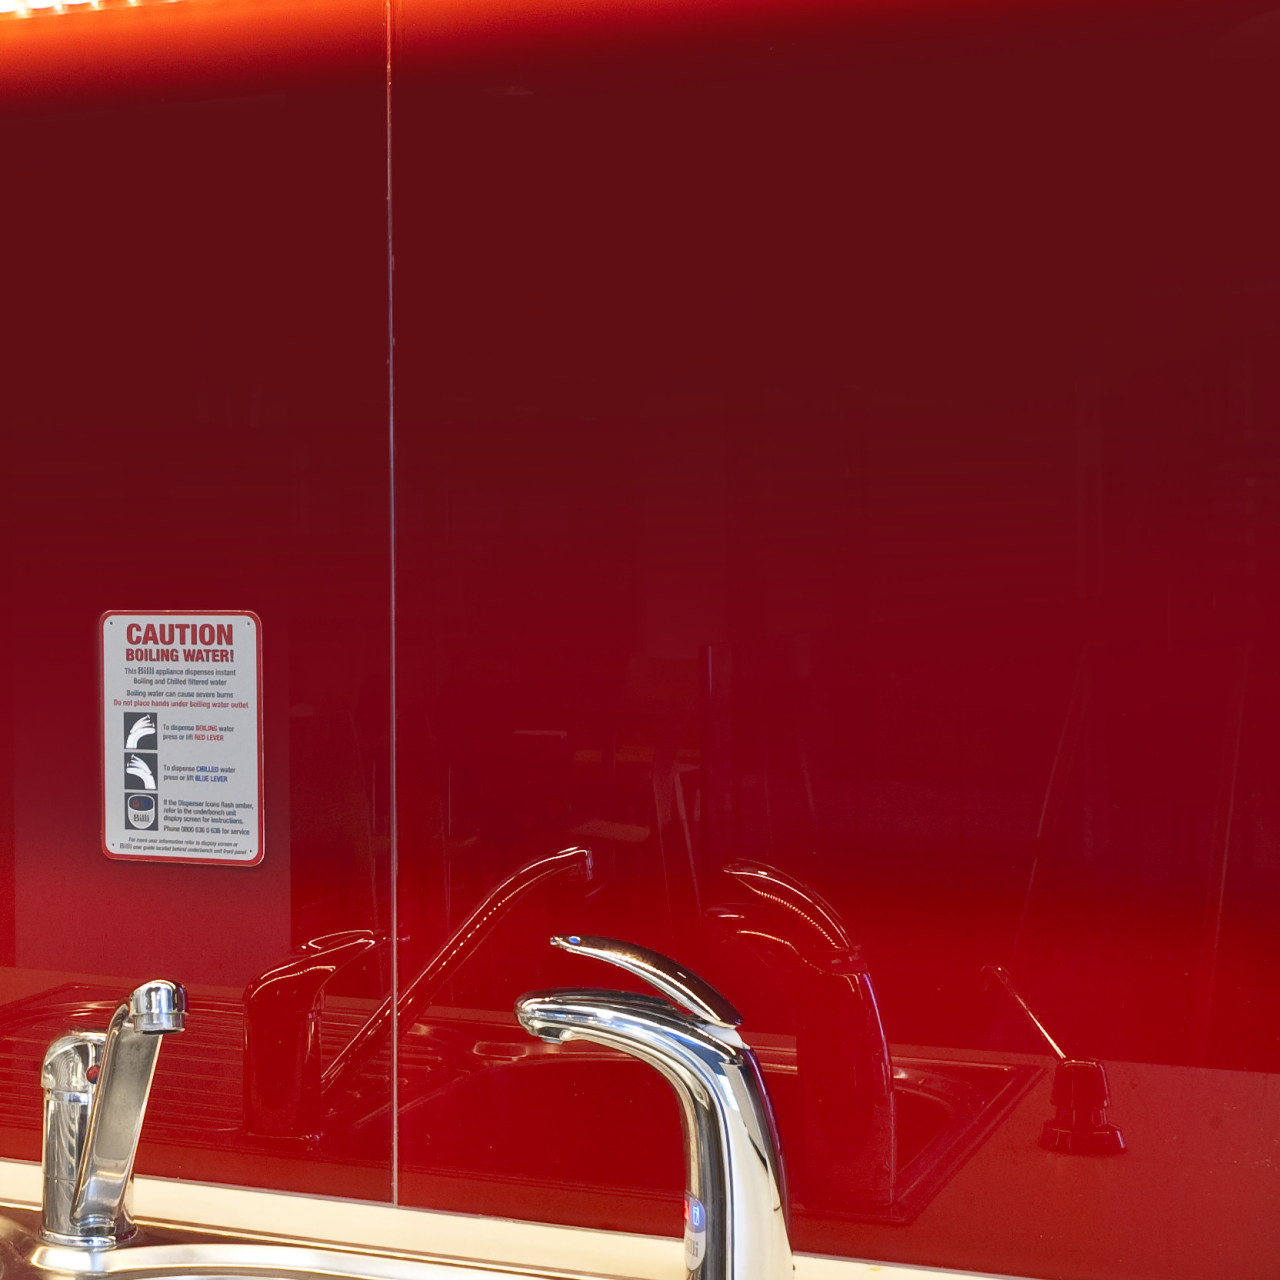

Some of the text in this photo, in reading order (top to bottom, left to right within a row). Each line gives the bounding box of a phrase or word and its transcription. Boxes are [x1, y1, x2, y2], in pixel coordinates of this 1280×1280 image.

[126, 623, 234, 646] CAUTION
[125, 648, 234, 663] BOILING WATER!
[125, 666, 236, 677] This Billi appliance dispenses instant
[133, 677, 153, 686] Boiling
[188, 678, 209, 686] filtered
[126, 689, 147, 698] Boiling
[216, 691, 234, 699] burns
[133, 699, 150, 707] place
[171, 700, 188, 708] under
[189, 700, 211, 709] boiling
[230, 701, 249, 709] outlet
[162, 723, 170, 731] To
[170, 724, 195, 732] dispense
[195, 724, 218, 732] BOILING
[171, 764, 195, 773] dispense
[196, 765, 219, 773] CHILLED
[163, 774, 179, 782] press
[195, 774, 209, 782] BLUE
[210, 775, 228, 783] LEVER
[177, 799, 205, 808] Dispenser
[220, 801, 234, 809] flash
[235, 802, 253, 810] amber,
[192, 808, 225, 816] underbench
[133, 813, 150, 822] Billi
[163, 815, 182, 823] display
[211, 817, 244, 825] instructions.
[163, 824, 180, 832] Phone
[221, 827, 230, 835] for
